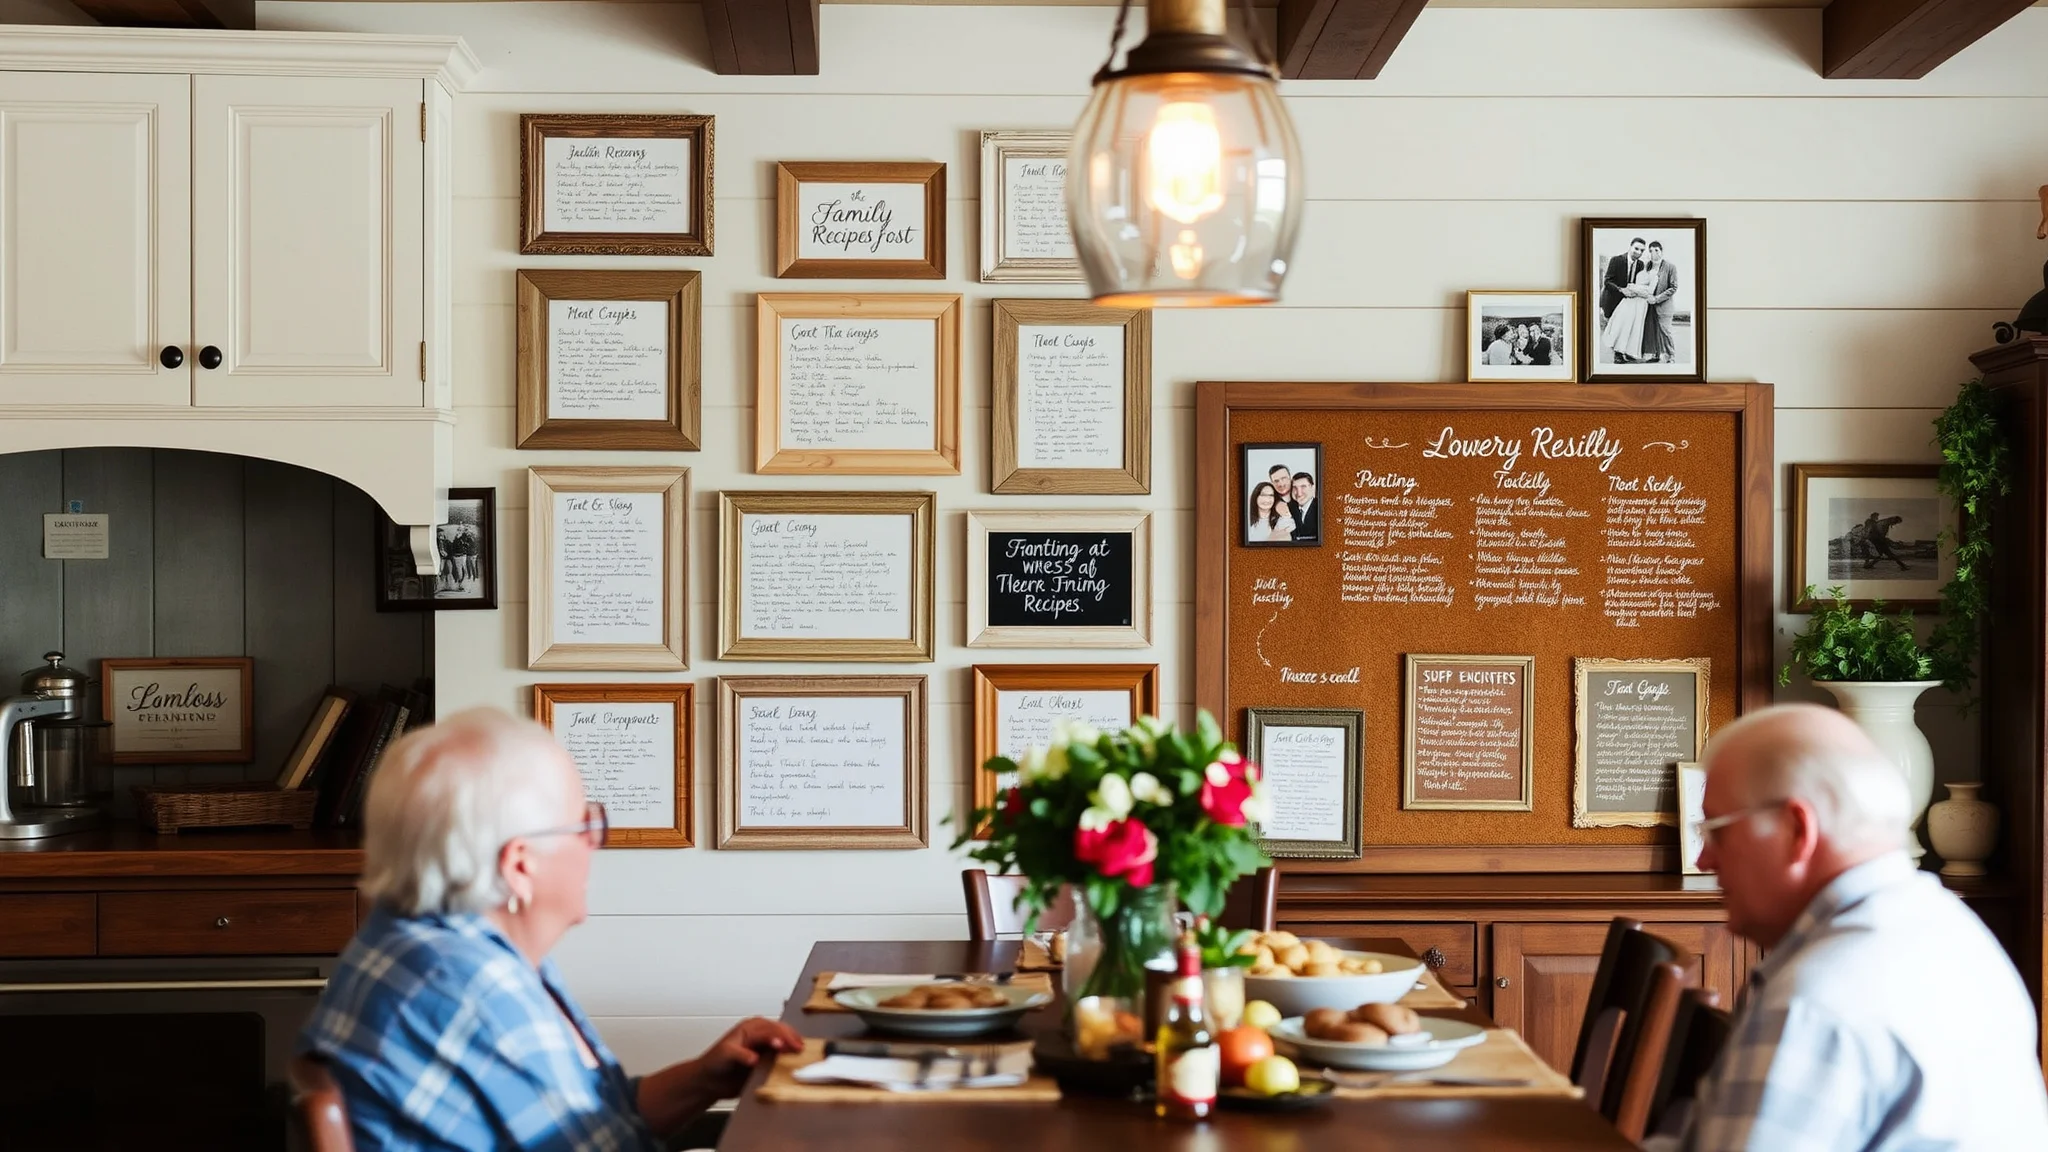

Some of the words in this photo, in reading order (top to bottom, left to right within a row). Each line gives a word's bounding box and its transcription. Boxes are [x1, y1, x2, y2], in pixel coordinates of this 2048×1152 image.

[811, 199, 893, 232] Family
[812, 224, 873, 252] Recipes
[1422, 426, 1521, 471] Lowery
[1530, 426, 1623, 473] Resilly
[1088, 538, 1111, 557] at
[1024, 594, 1085, 620] Recipes.
